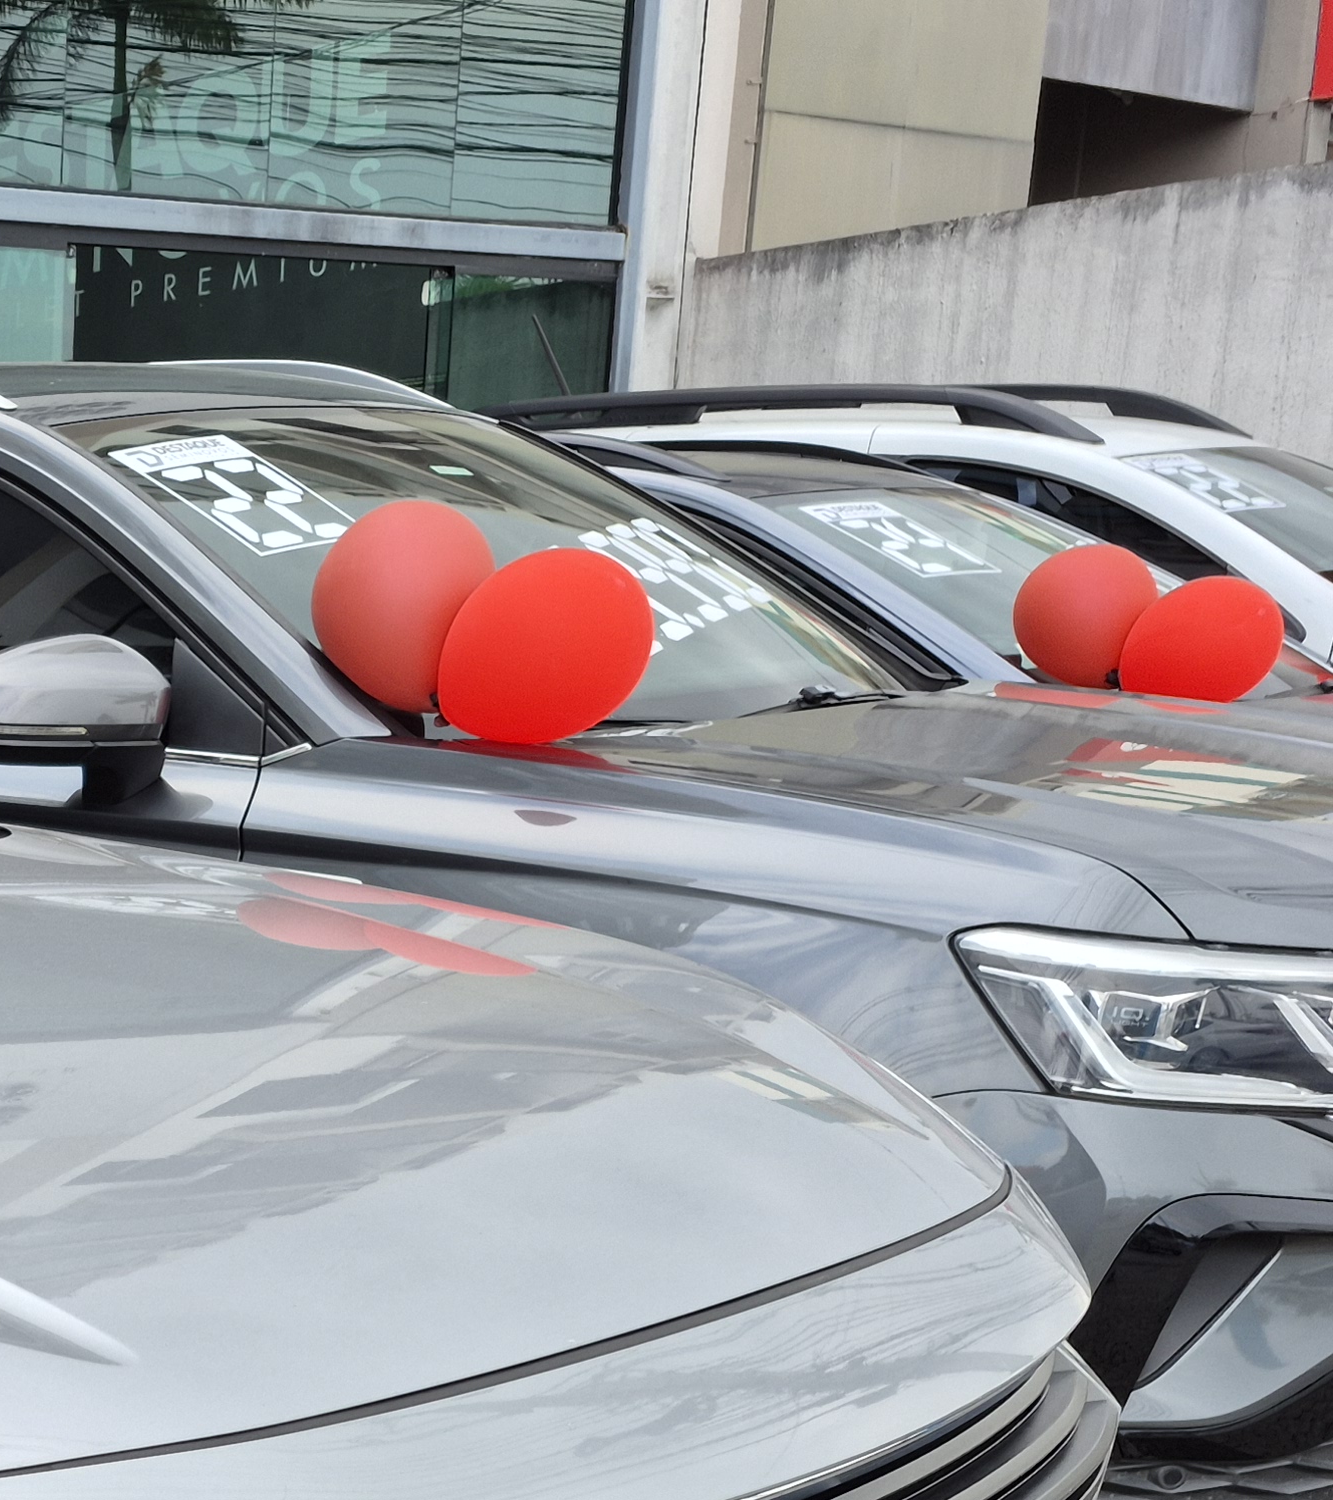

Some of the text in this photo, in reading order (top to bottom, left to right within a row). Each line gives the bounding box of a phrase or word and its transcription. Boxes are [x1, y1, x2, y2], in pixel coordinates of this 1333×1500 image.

[130, 258, 379, 307] PREMIU
[151, 438, 226, 455] DESTAQUE
[160, 458, 349, 548] 22
[839, 516, 985, 573] 24
